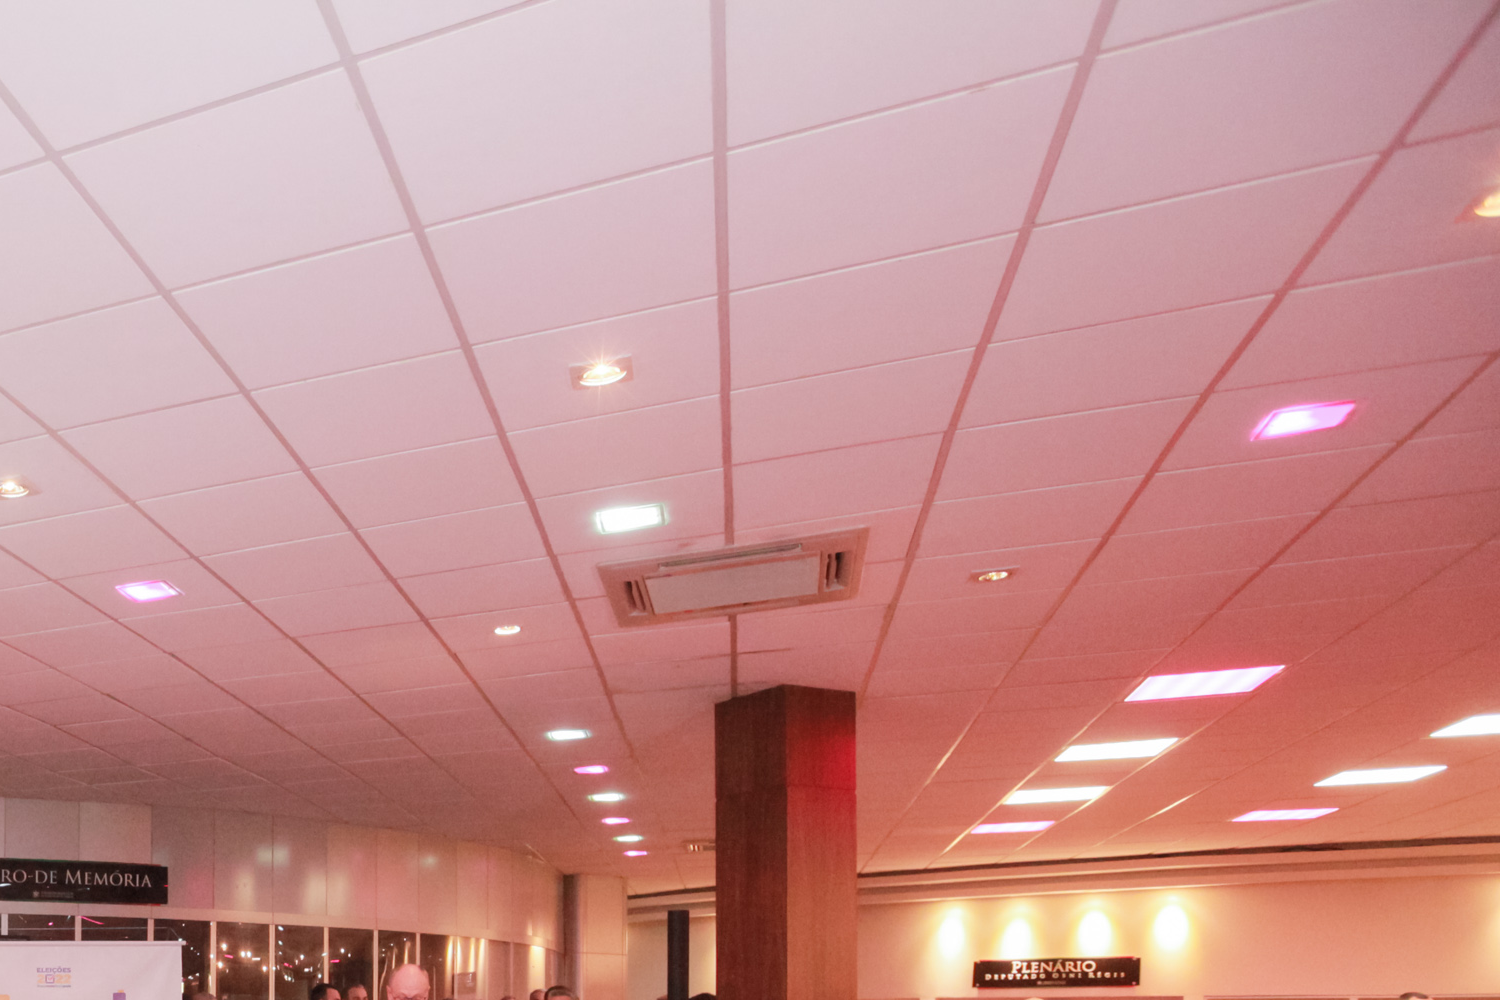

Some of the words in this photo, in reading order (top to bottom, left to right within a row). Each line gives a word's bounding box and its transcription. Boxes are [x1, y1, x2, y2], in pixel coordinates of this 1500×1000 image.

[65, 869, 152, 888] MEMÓRIA
[1012, 960, 1097, 974] PLENÁRIO
[985, 973, 1046, 981] DEPUTADO
